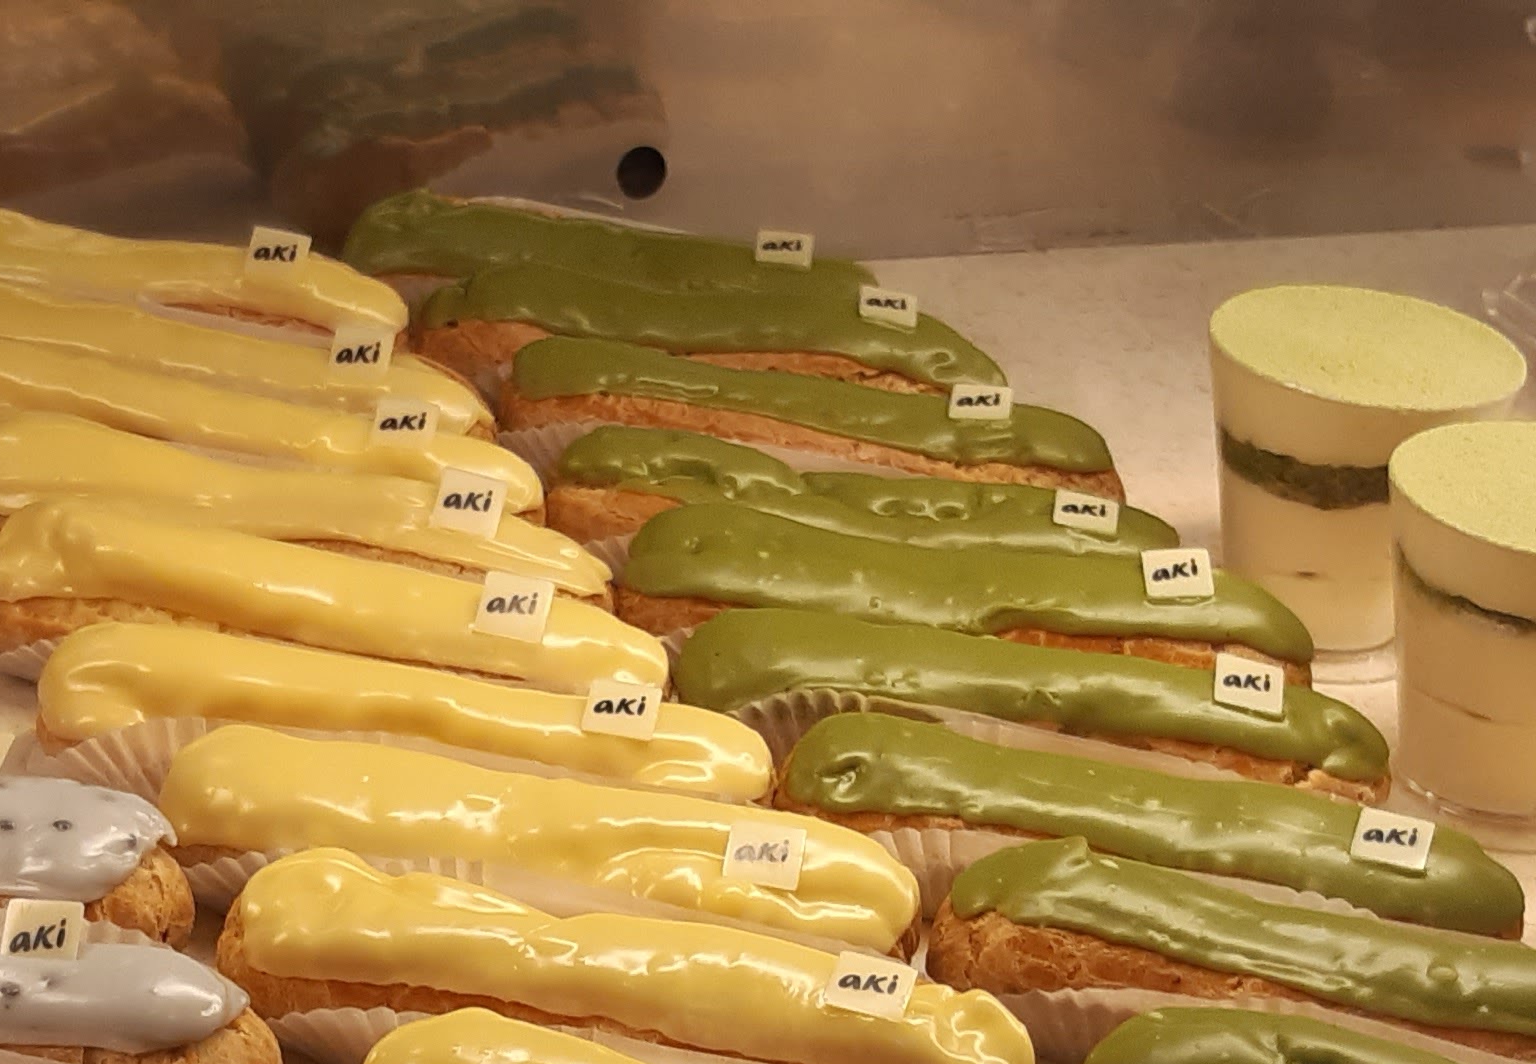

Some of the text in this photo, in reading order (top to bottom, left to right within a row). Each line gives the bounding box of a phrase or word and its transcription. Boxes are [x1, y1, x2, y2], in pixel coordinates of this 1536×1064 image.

[253, 245, 297, 262] aki
[762, 240, 802, 251] aki
[866, 298, 906, 310] aki
[336, 342, 380, 363] aki
[957, 394, 1000, 406] aki
[380, 413, 426, 430] aki
[443, 490, 492, 512] aki
[1061, 504, 1106, 517] aki
[1152, 559, 1197, 581] aki
[486, 593, 537, 614] aki
[1223, 674, 1270, 692] aki
[594, 697, 646, 715] aki
[1363, 828, 1417, 846] aki
[735, 840, 789, 862] aki
[10, 919, 66, 953] aki
[838, 975, 898, 994] aki
